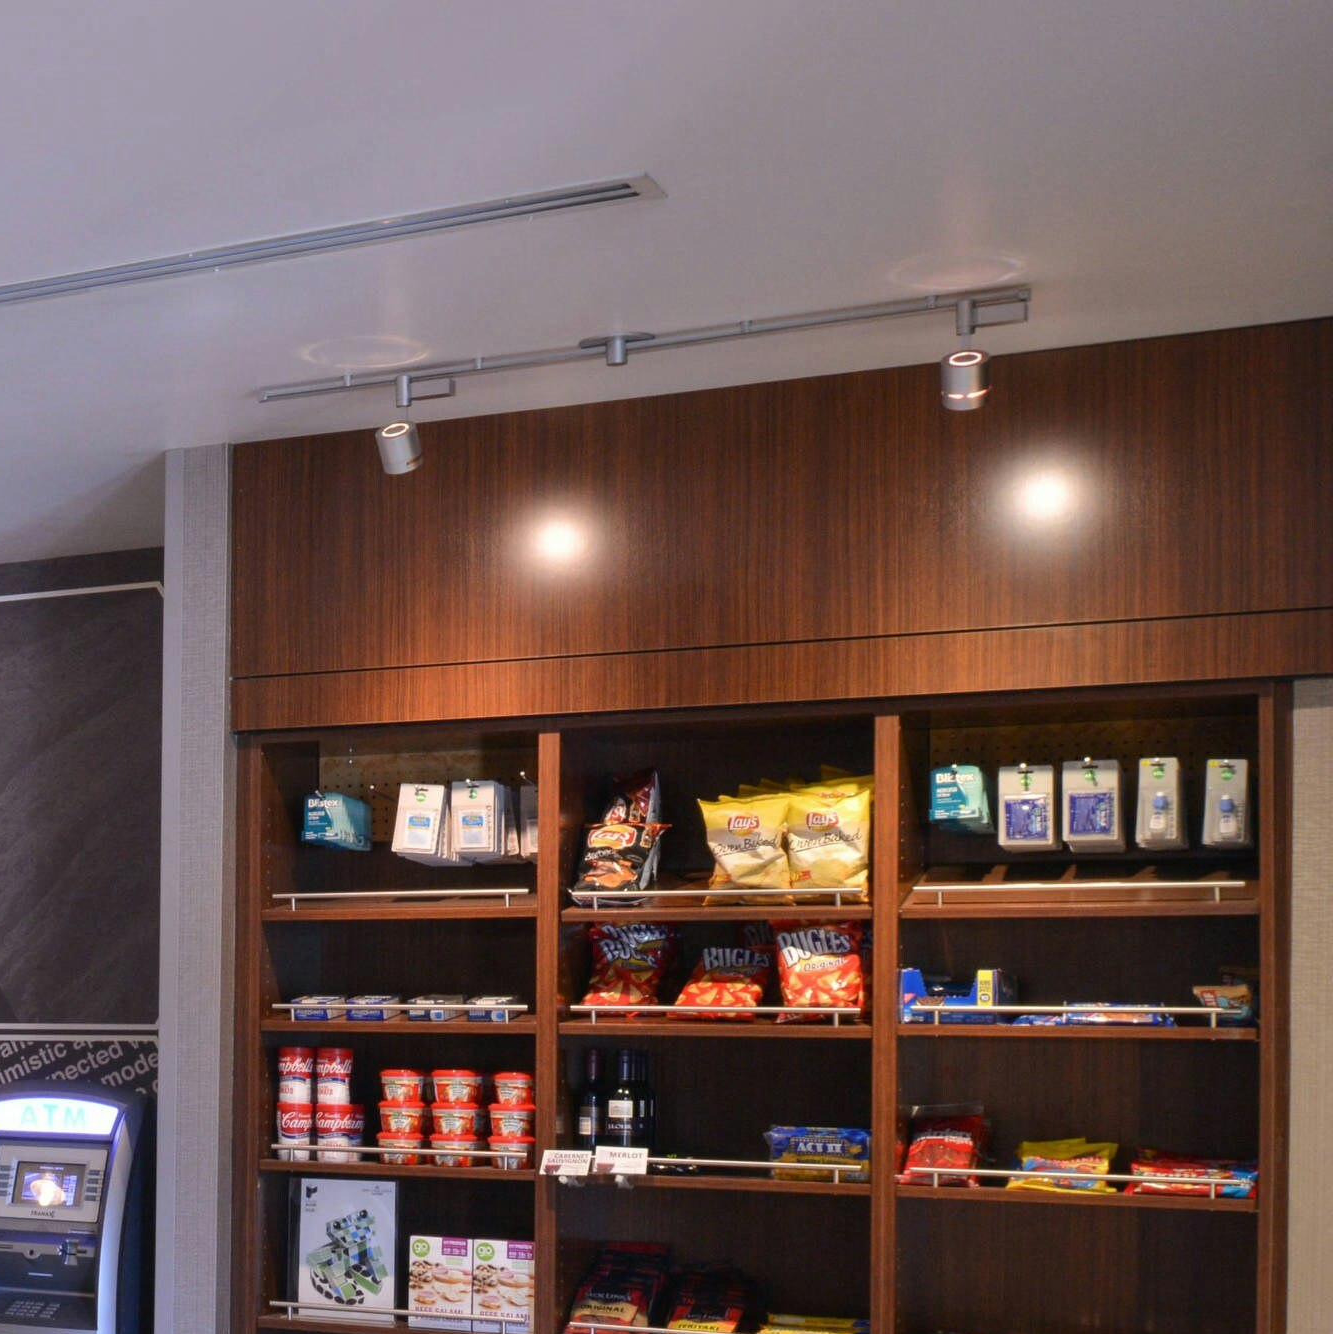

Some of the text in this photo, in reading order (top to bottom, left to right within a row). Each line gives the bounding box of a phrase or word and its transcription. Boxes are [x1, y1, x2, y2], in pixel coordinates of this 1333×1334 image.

[743, 832, 779, 850] Baked
[824, 828, 861, 843] Baked
[776, 928, 851, 960] BUGLES
[20, 1104, 87, 1129] ATM
[797, 1143, 842, 1153] ACT II
[546, 1157, 589, 1165] SAUVIGNON
[609, 1151, 644, 1160] MERLOT
[580, 1303, 626, 1313] ORIGINAL
